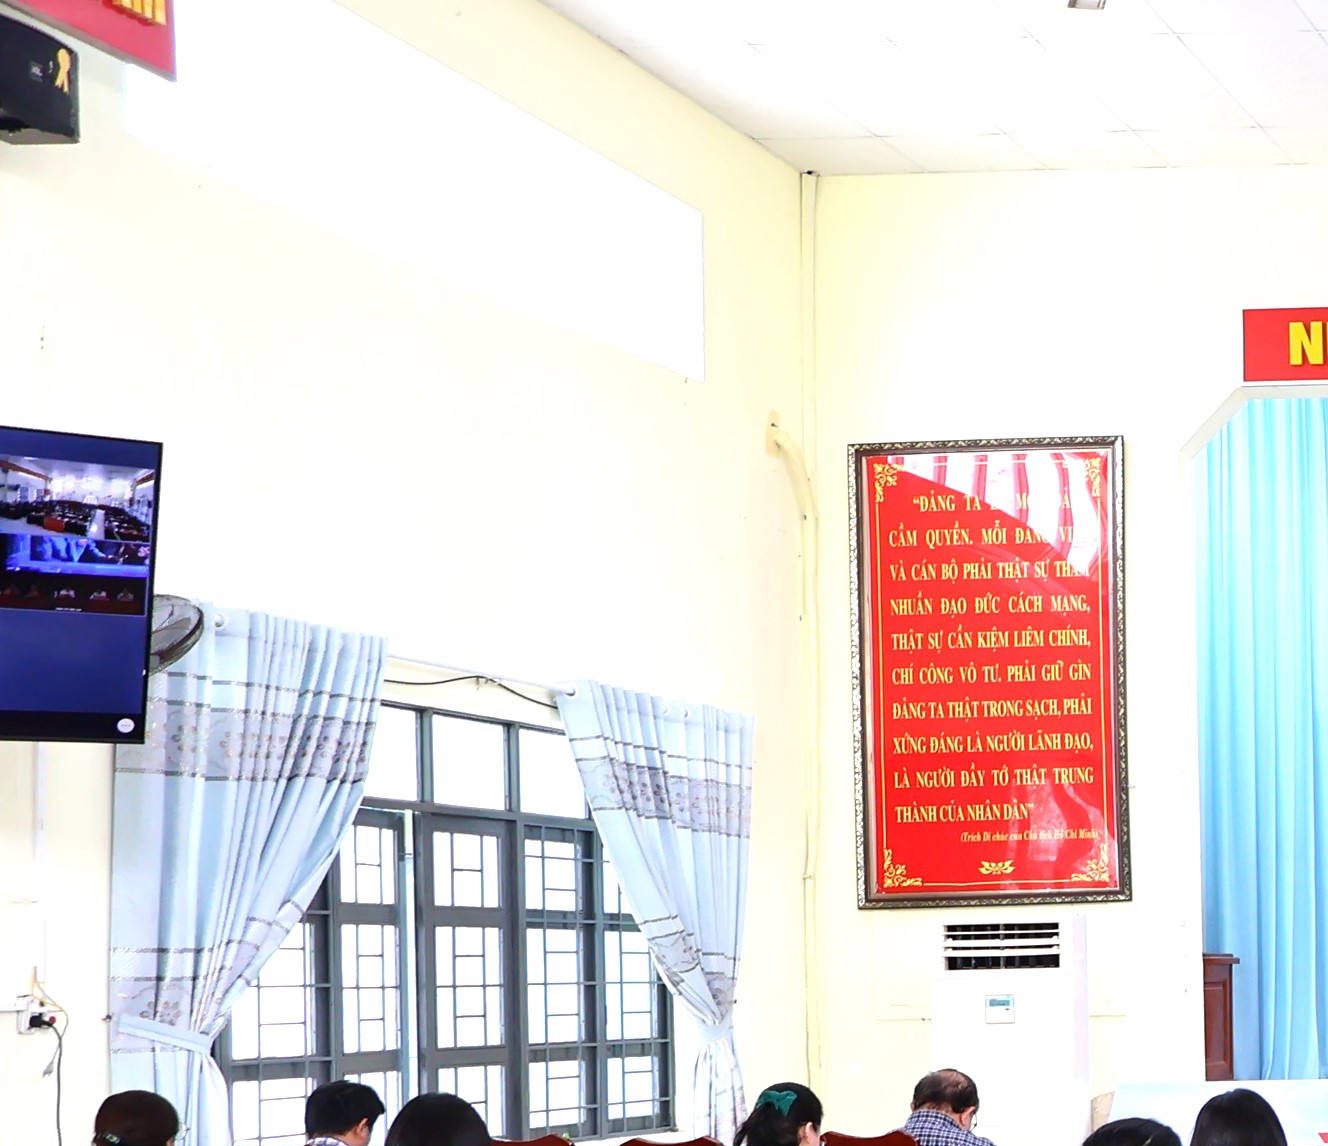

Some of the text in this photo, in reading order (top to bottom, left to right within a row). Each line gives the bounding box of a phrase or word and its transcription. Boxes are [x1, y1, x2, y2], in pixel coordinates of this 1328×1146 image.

[914, 490, 955, 512] “ĐẢNG
[964, 495, 981, 510] TA
[889, 520, 1007, 549] CẦM QUYỀN. MỖI
[890, 555, 1050, 583] VÀ CÁN BỘ PHẢI THẬT SỰ
[891, 591, 1090, 618] NHUẦN ĐẠO ĐỨC CÁCH MẠNG,
[891, 625, 1091, 654] THẬT SỰ CẦN KIỆM LIÊM CHÍNH,
[892, 659, 1091, 684] CHÍ CÔNG VÔ TƯ. PHẢI GIỮ GÌN
[892, 693, 1092, 722] ĐẢNG TA THẬT TRONG SẠCH, PHẢI
[894, 730, 1093, 754] XỨNG ĐÁNG LÀ NGƯỜI LÃNH ĐẠO,
[894, 767, 910, 788] LÀ
[916, 766, 955, 788] NGƯỜI
[992, 765, 1008, 786] TỚ
[1014, 764, 1047, 789] THẬT
[1053, 767, 1093, 784] TRUNG
[895, 802, 937, 823] THÀNH
[940, 800, 964, 822] CỦA
[967, 800, 1000, 821] NHÂN
